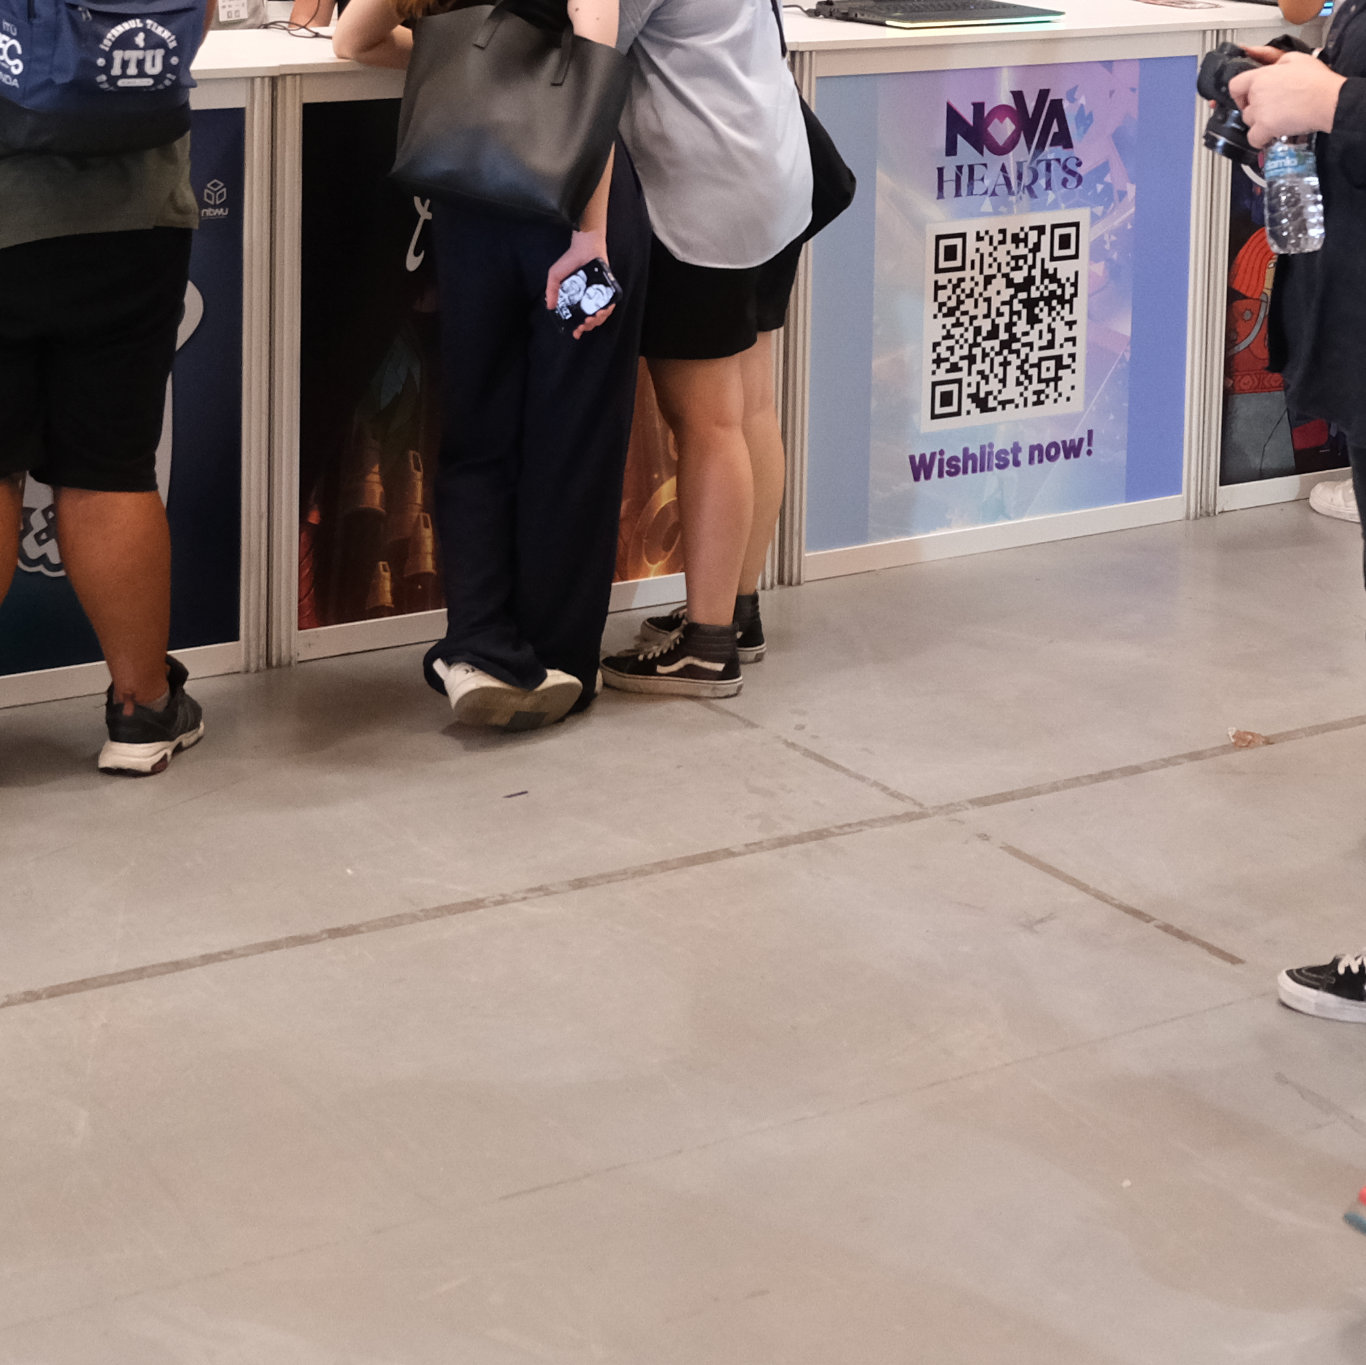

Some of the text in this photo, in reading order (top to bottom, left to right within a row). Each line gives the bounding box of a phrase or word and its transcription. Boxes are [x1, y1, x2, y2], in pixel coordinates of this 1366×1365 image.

[945, 89, 1074, 158] NOVA
[936, 156, 1083, 201] HEARTS
[909, 429, 1094, 482] Wishlist now!
